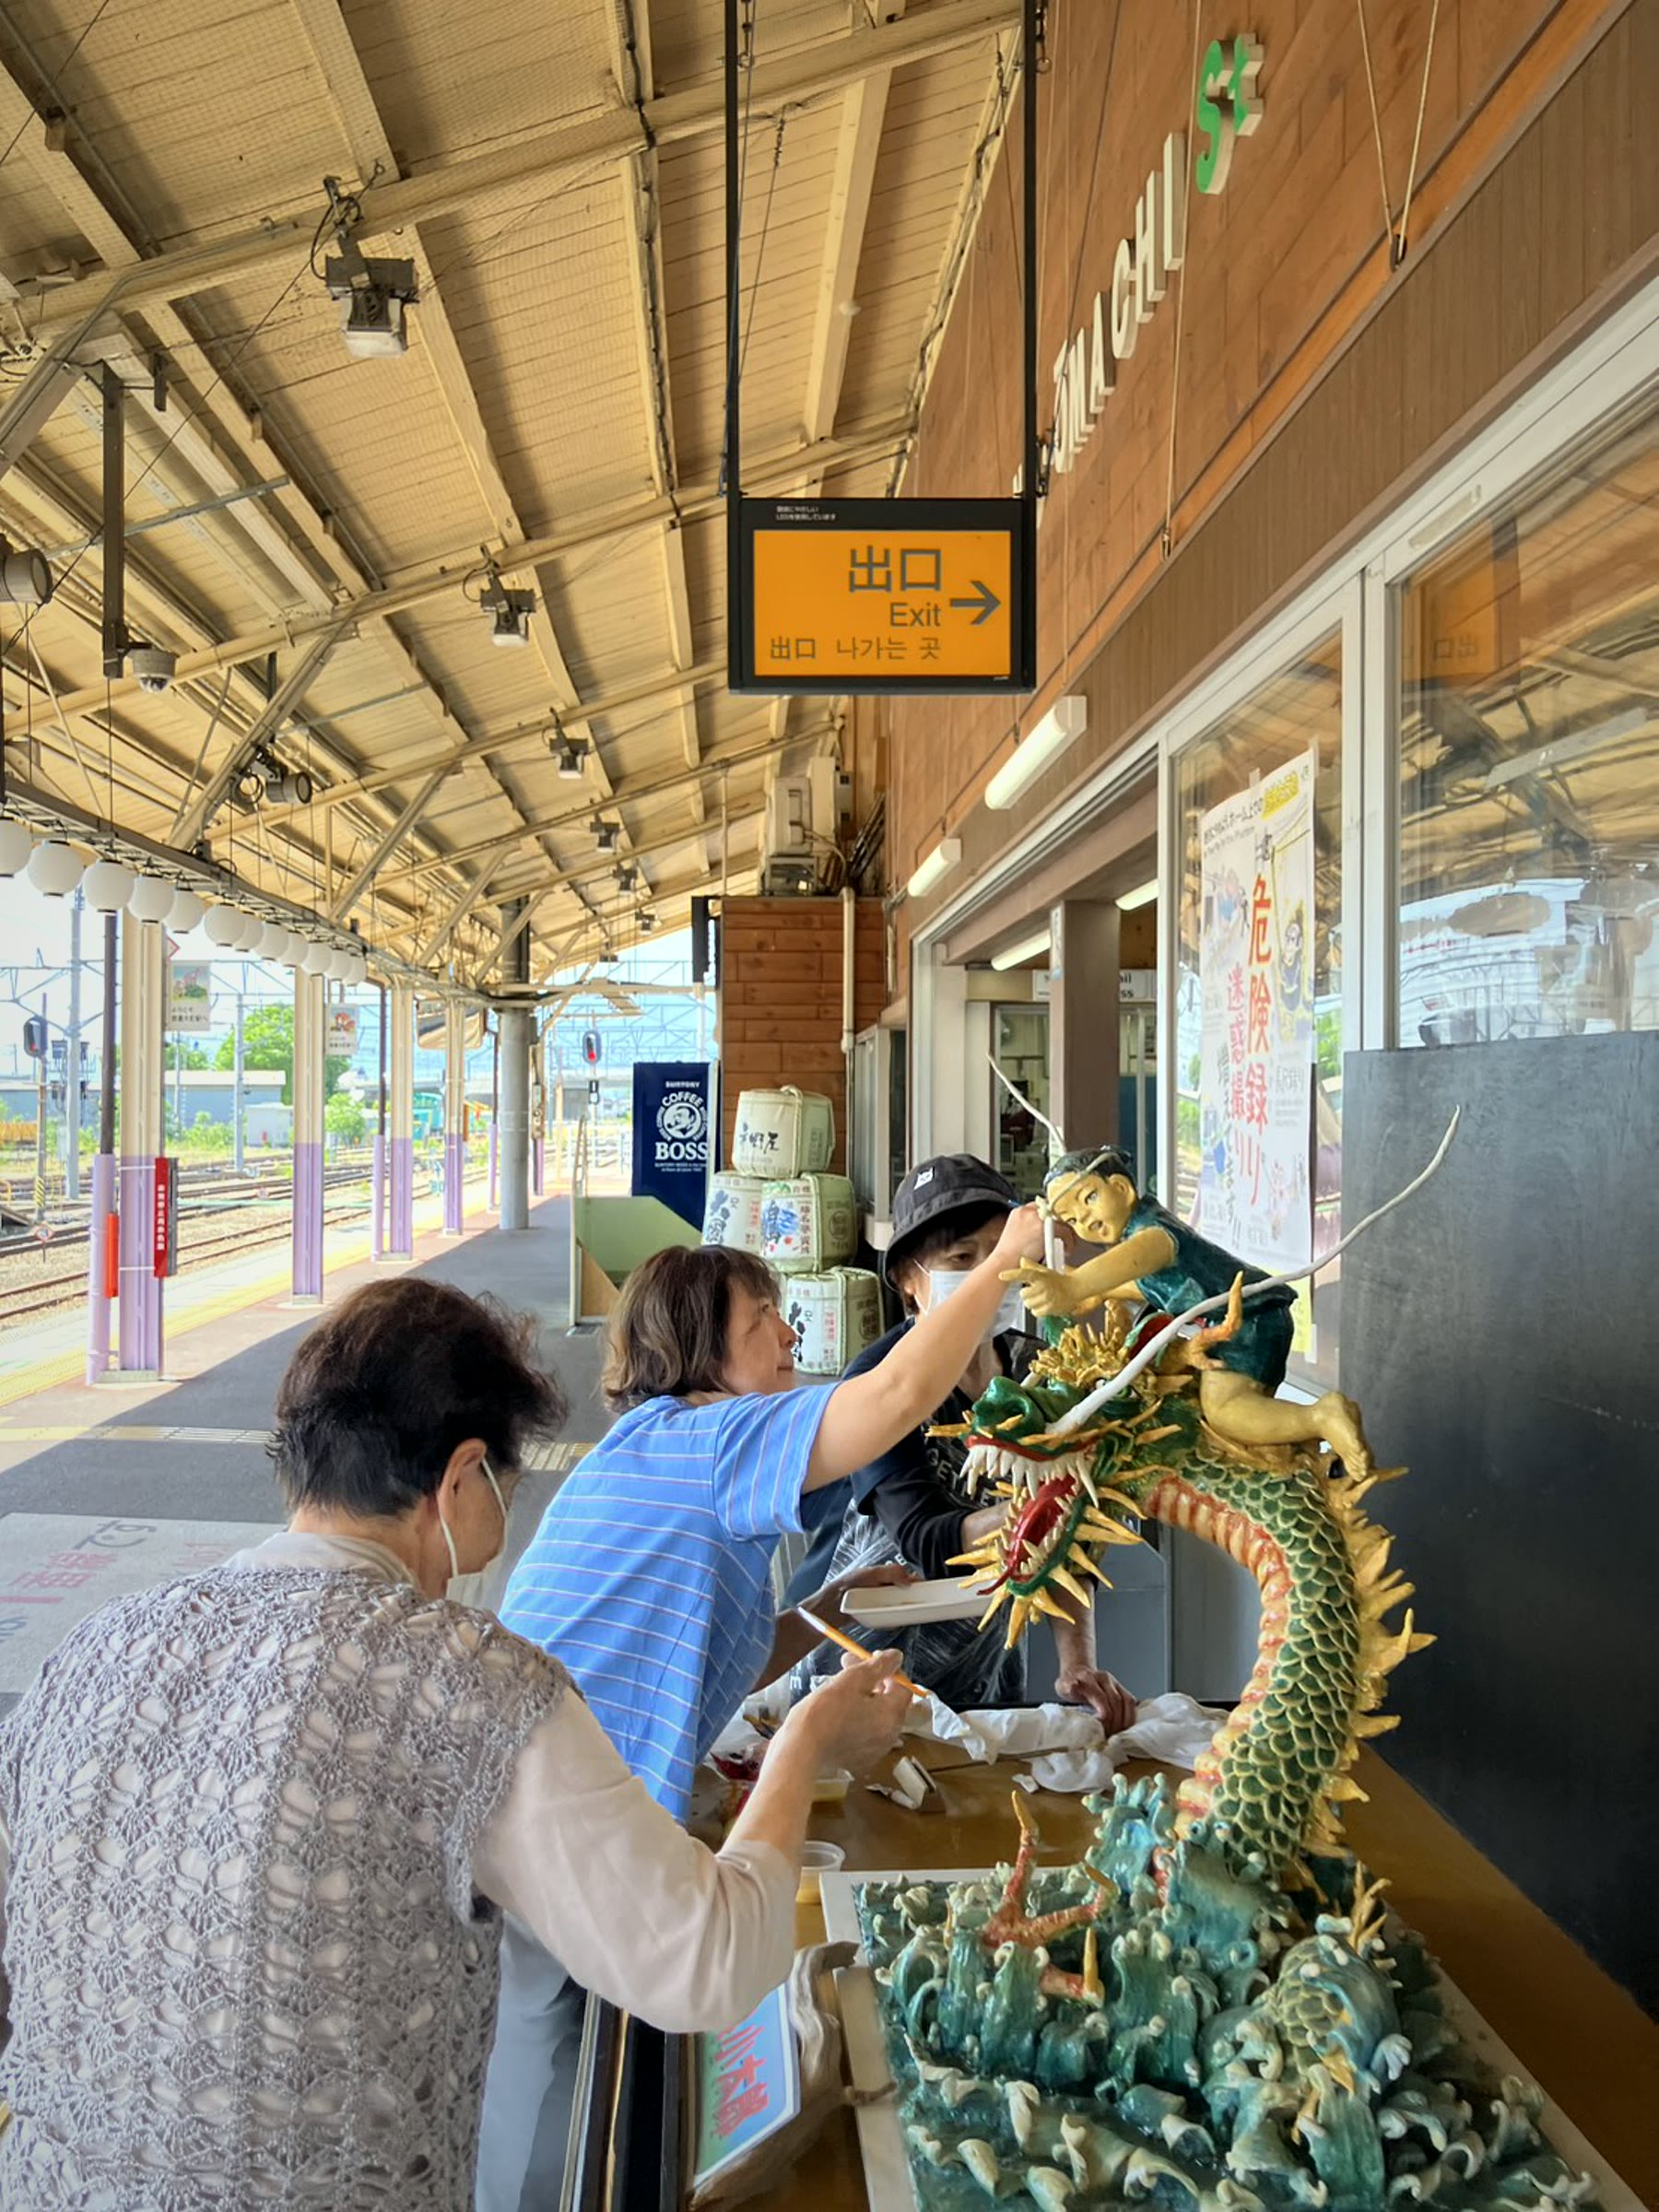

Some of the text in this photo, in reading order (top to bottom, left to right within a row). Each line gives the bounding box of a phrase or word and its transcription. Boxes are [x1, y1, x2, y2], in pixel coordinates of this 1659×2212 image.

[849, 545, 941, 592] 出口
[890, 603, 941, 627] Exit
[771, 637, 816, 660] 出口
[837, 636, 940, 659] 나가는 곳
[662, 1091, 704, 1107] COFFEE
[654, 1141, 709, 1161] BOSS
